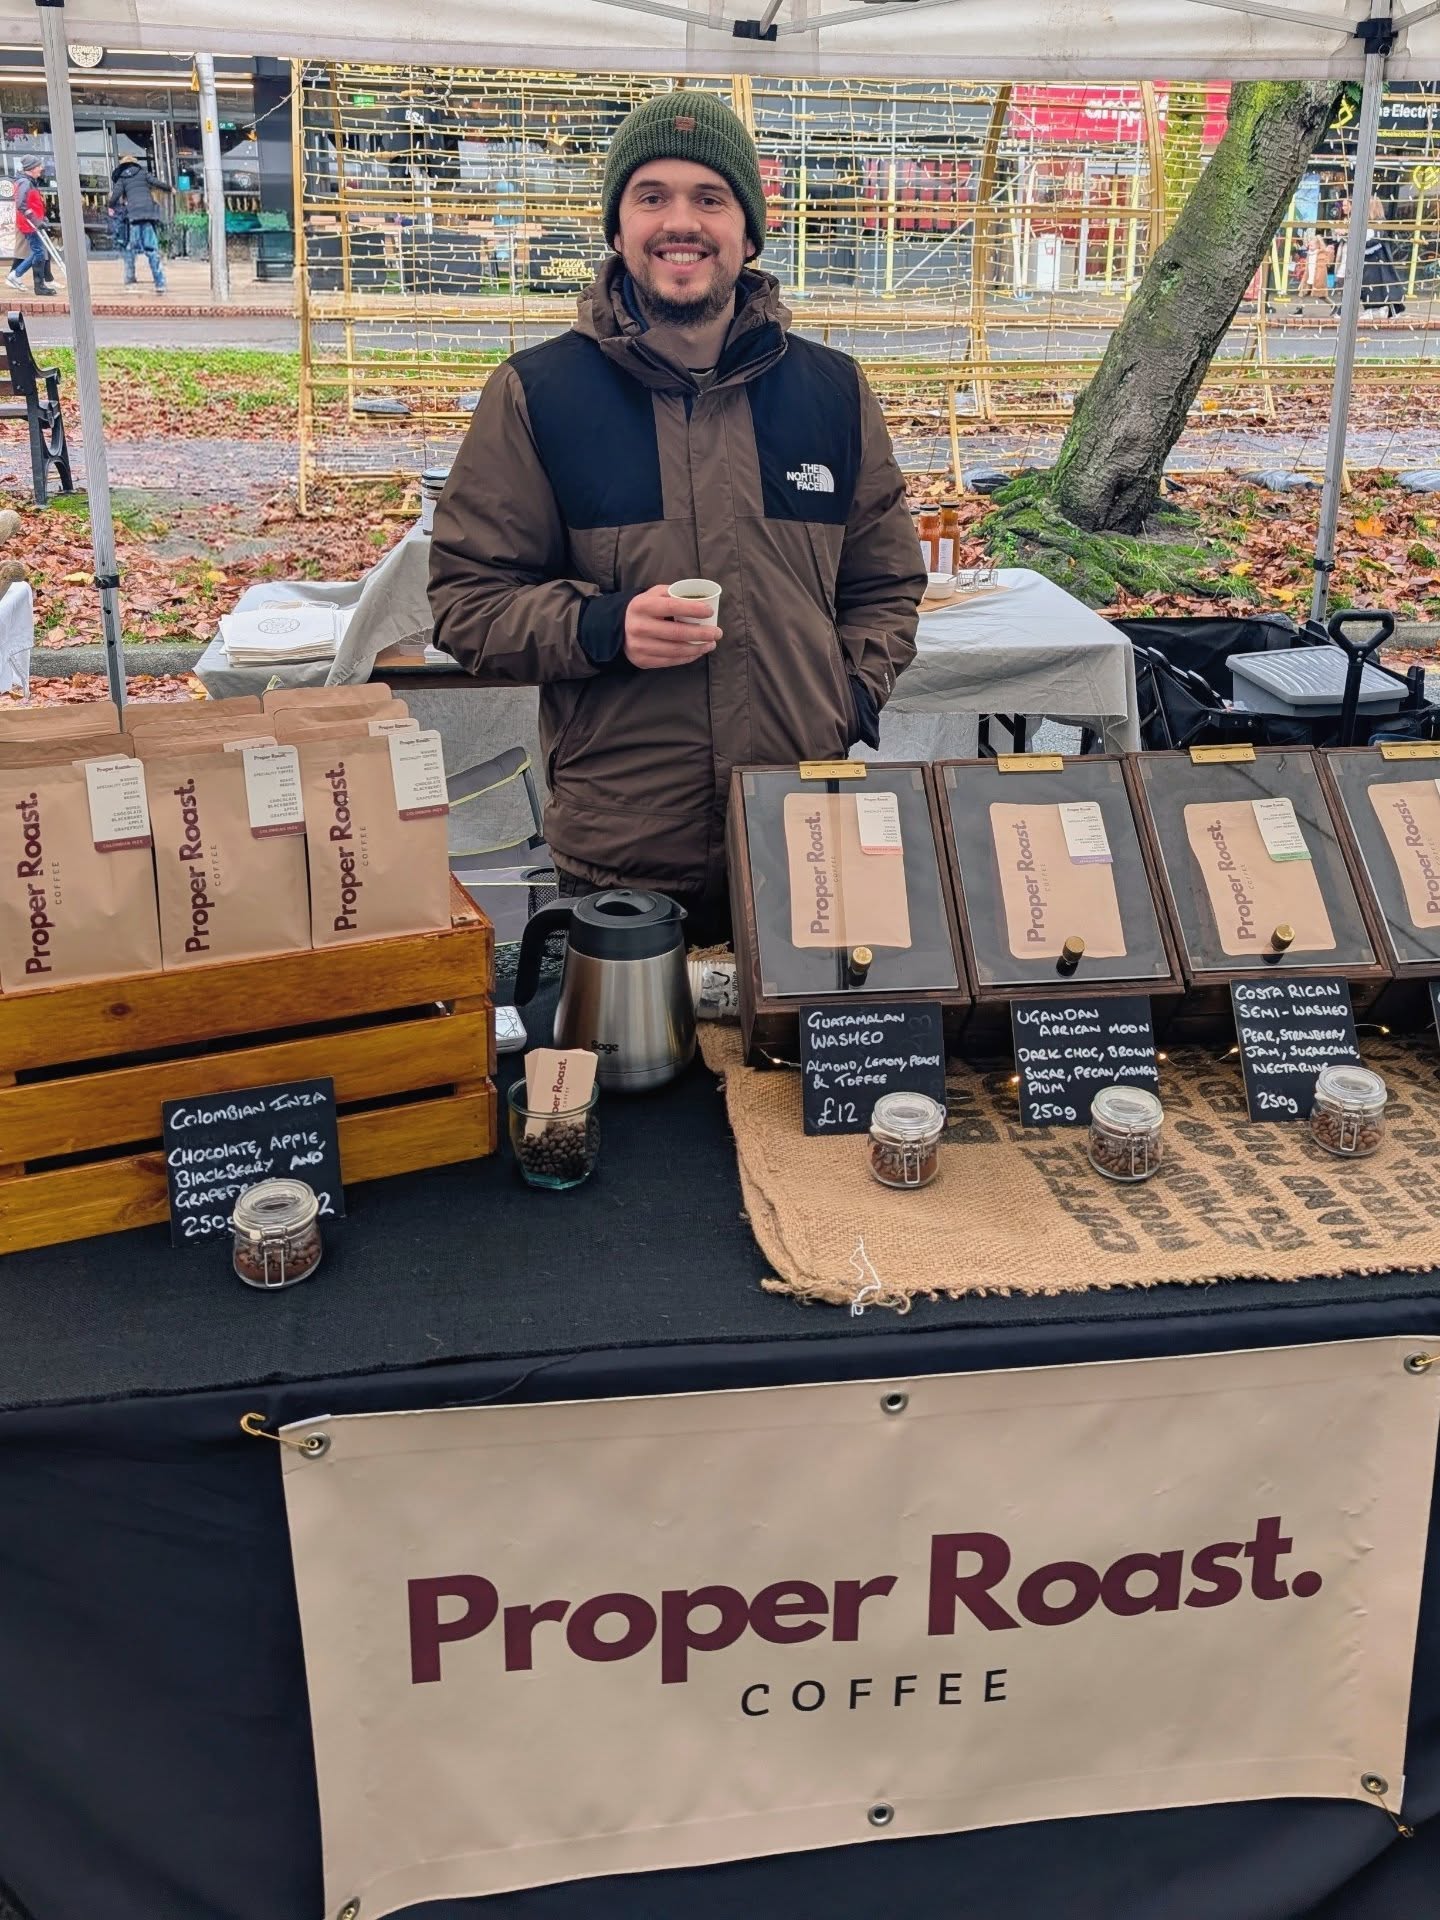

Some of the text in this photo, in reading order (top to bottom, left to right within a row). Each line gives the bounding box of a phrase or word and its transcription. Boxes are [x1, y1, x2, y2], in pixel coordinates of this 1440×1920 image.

[540, 266, 594, 277] EXPRESS
[550, 258, 585, 268] PIZZA
[786, 471, 819, 482] NORTH
[801, 463, 820, 473] THE
[796, 481, 820, 491] FACE
[325, 762, 363, 931] Proper Roast.
[360, 826, 368, 867] COFFEE
[1392, 799, 1440, 913] Proper Roast.
[173, 778, 216, 952] Proper Roast.
[211, 844, 221, 887] COFFEE
[805, 811, 833, 934] Proper Roast.
[15, 792, 56, 974] Proper Roast.
[52, 861, 62, 905] COFFEE
[1012, 820, 1047, 942] Proper Roast.
[1207, 820, 1256, 940] Proper Roast.
[731, 971, 739, 991] White
[1235, 983, 1341, 1000] COSTA RICAN
[807, 1011, 905, 1029] GUATAMALAN
[1017, 1009, 1099, 1025] UGANDAN
[1108, 1023, 1150, 1034] MOON
[1280, 1029, 1346, 1041] STRAWBERRY
[591, 1040, 619, 1054] Sage
[811, 1031, 884, 1049] WASHED
[1018, 1046, 1155, 1062] DARK CHOC, BROWN
[1245, 1046, 1286, 1060] JAM,
[806, 1060, 862, 1074] ALMOND,
[909, 1055, 940, 1067] PEACH
[1025, 1066, 1071, 1082] SUGAR,
[1252, 1062, 1329, 1074] NECTARINE
[552, 1058, 567, 1114] per Roast.
[813, 1073, 888, 1089] & TOFFEE
[269, 1092, 326, 1111] INZA
[1257, 1092, 1298, 1114] 250g
[818, 1097, 858, 1126] £12
[1029, 1103, 1077, 1120] 250g
[290, 1151, 323, 1170] AND
[175, 1177, 275, 1208] GRAPEFR
[1279, 1175, 1383, 1250] HAND
[408, 1516, 1323, 1684] Proper Roast.
[740, 1669, 1008, 1716] COFFEE
